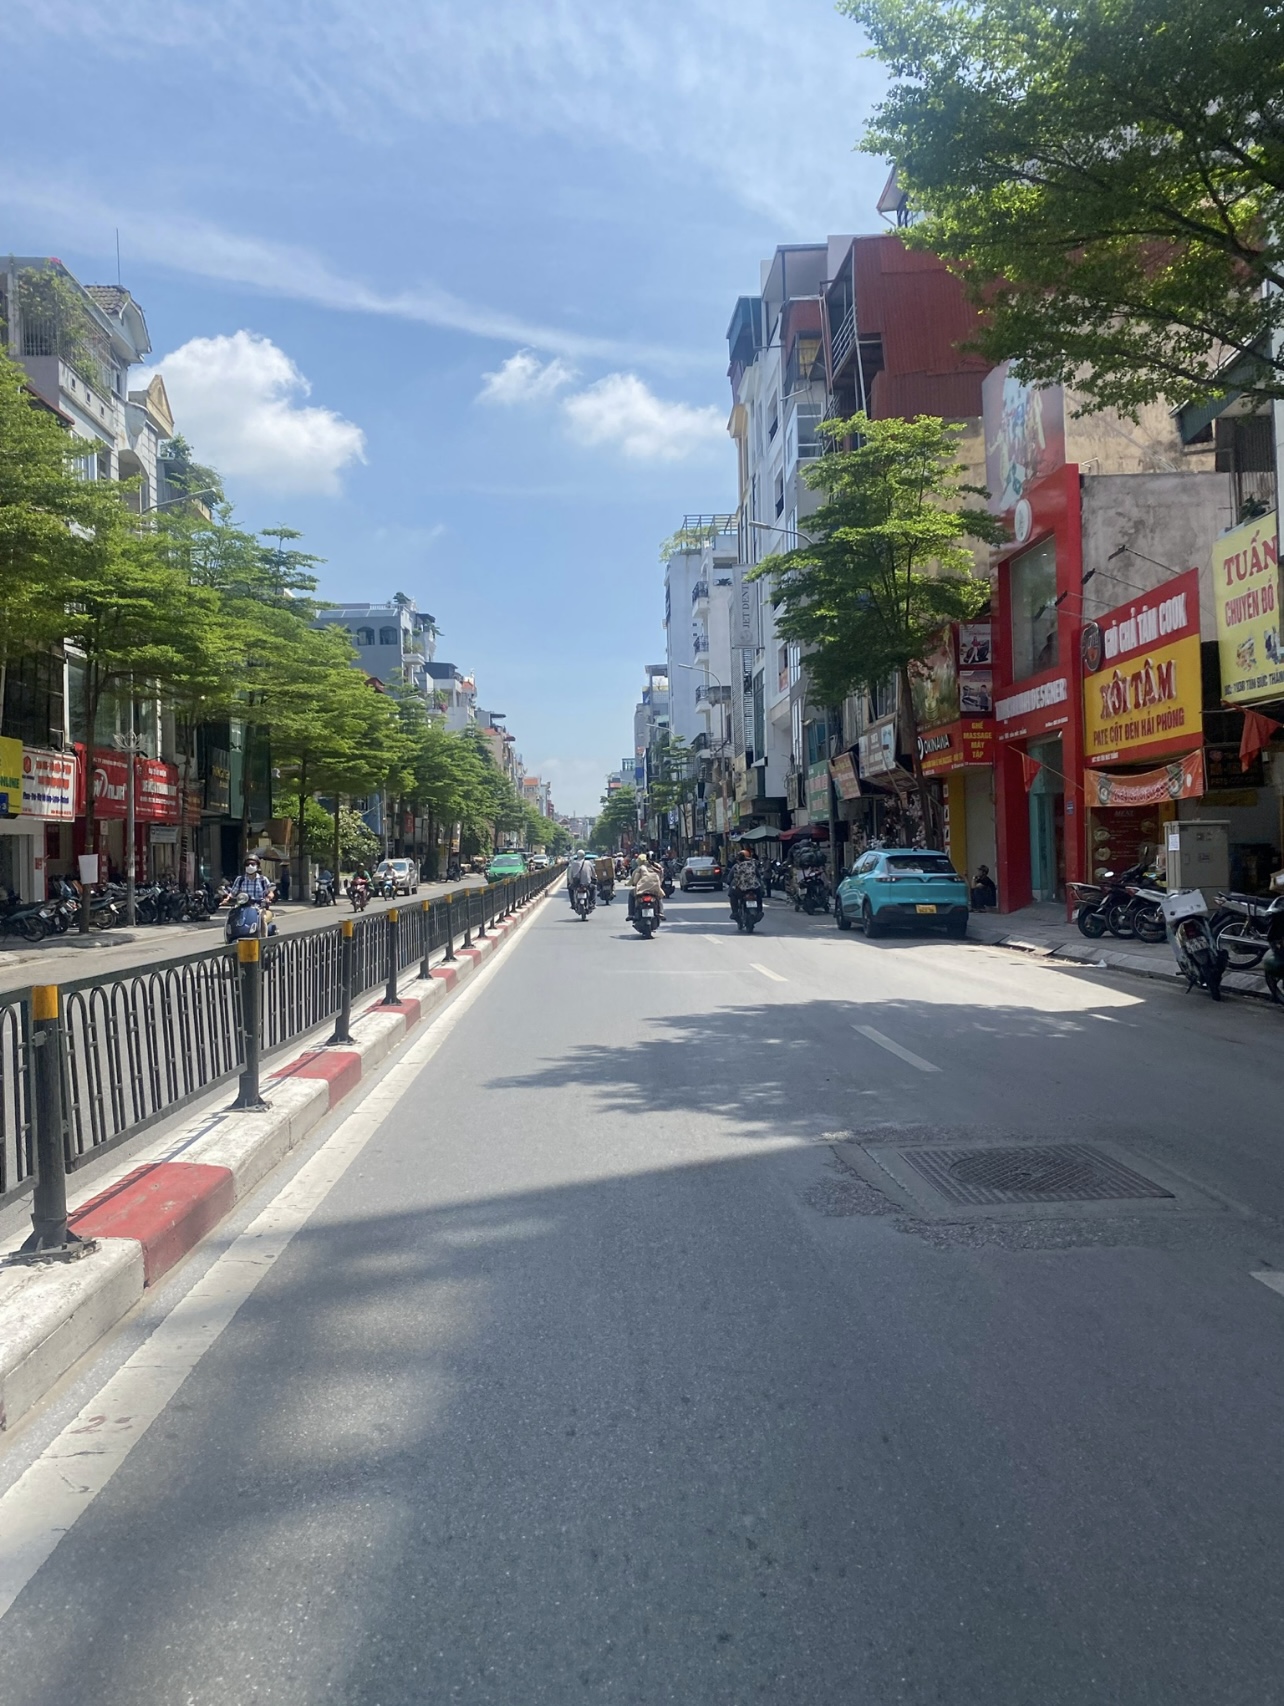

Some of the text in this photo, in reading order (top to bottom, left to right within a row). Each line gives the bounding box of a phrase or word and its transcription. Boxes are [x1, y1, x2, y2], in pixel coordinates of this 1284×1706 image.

[1223, 529, 1277, 586] TUẤN
[1104, 592, 1188, 660] GIÒ CHẢ TÂM COOK
[1225, 587, 1259, 628] CHUYÊN
[1100, 658, 1177, 720] XÔI TÂM
[924, 733, 950, 754] OKINAWA
[970, 741, 985, 749] MÁY
[971, 721, 984, 730] GHẾ
[1093, 728, 1109, 747] PATE
[1109, 721, 1123, 746] CỘT
[1125, 718, 1140, 741] ĐÈN
[1156, 705, 1185, 733] PHÒNG
[972, 750, 984, 760] TẬP
